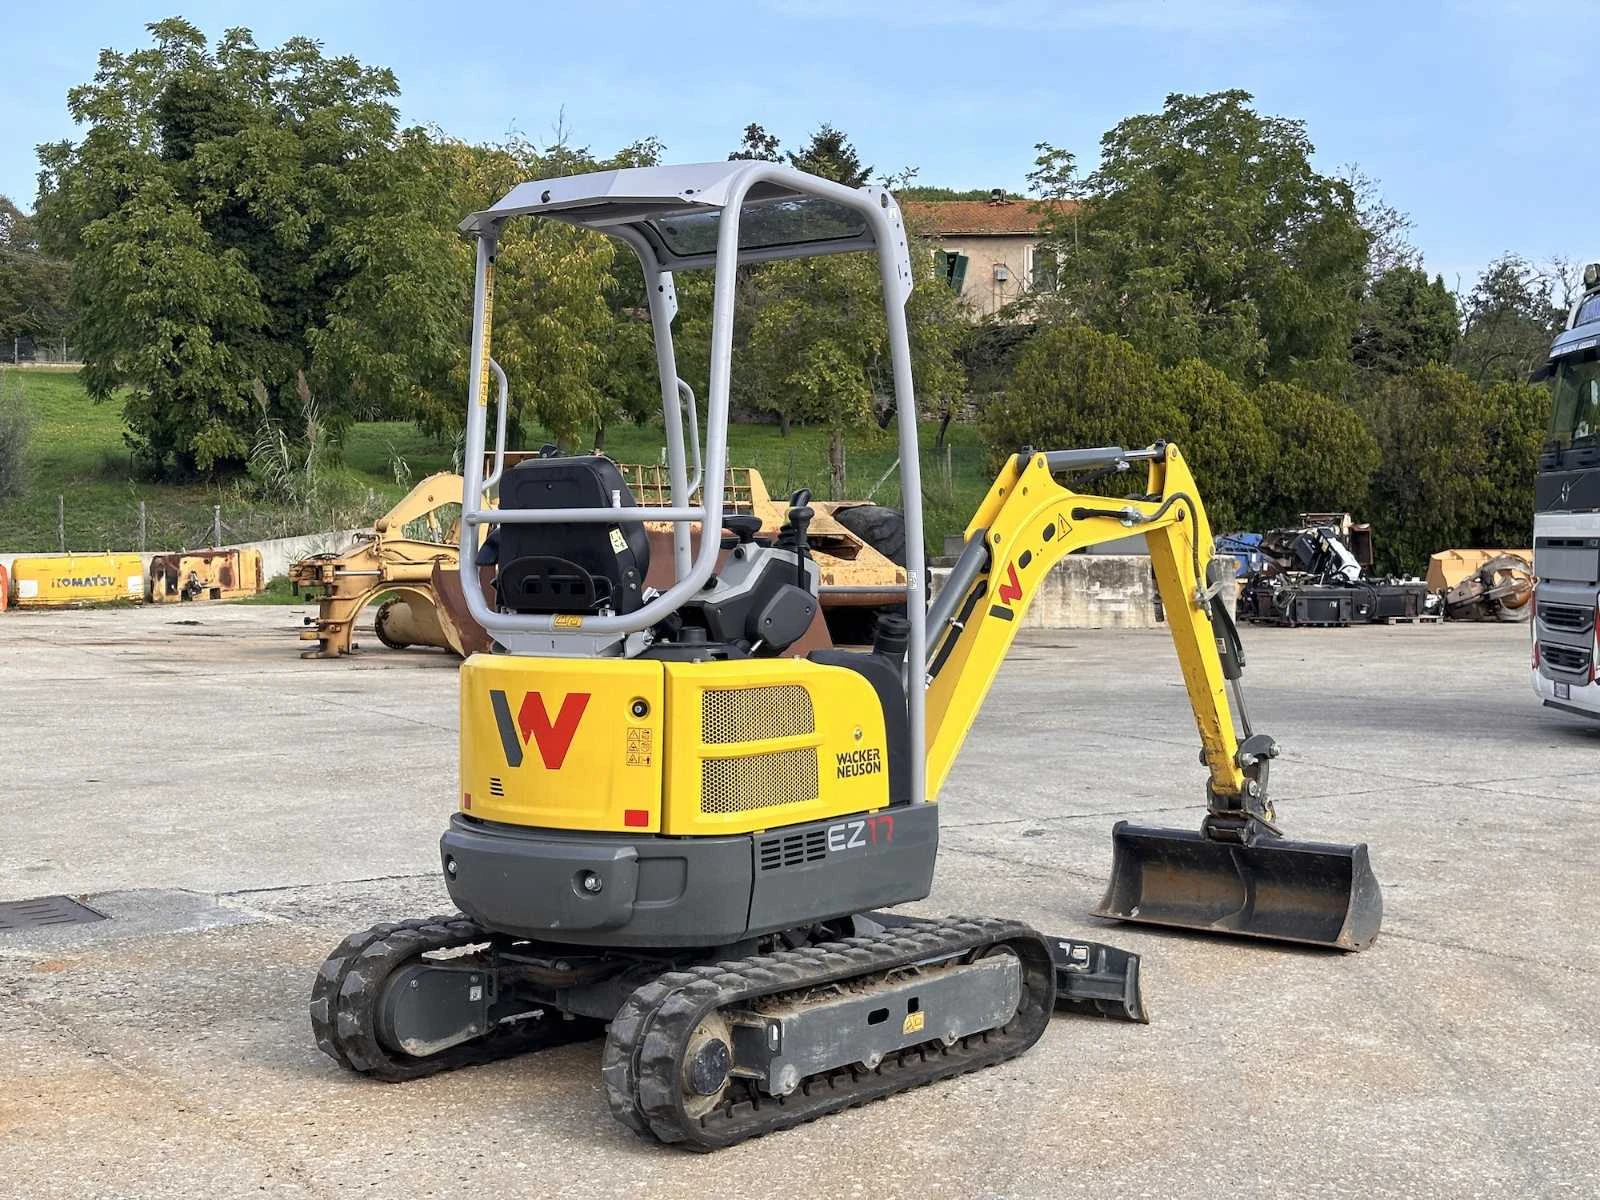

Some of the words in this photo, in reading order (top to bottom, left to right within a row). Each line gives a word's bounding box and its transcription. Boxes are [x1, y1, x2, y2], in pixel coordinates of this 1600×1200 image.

[51, 574, 116, 589] KOMATSU
[836, 748, 880, 766] WACKER
[837, 760, 881, 779] NEUSON
